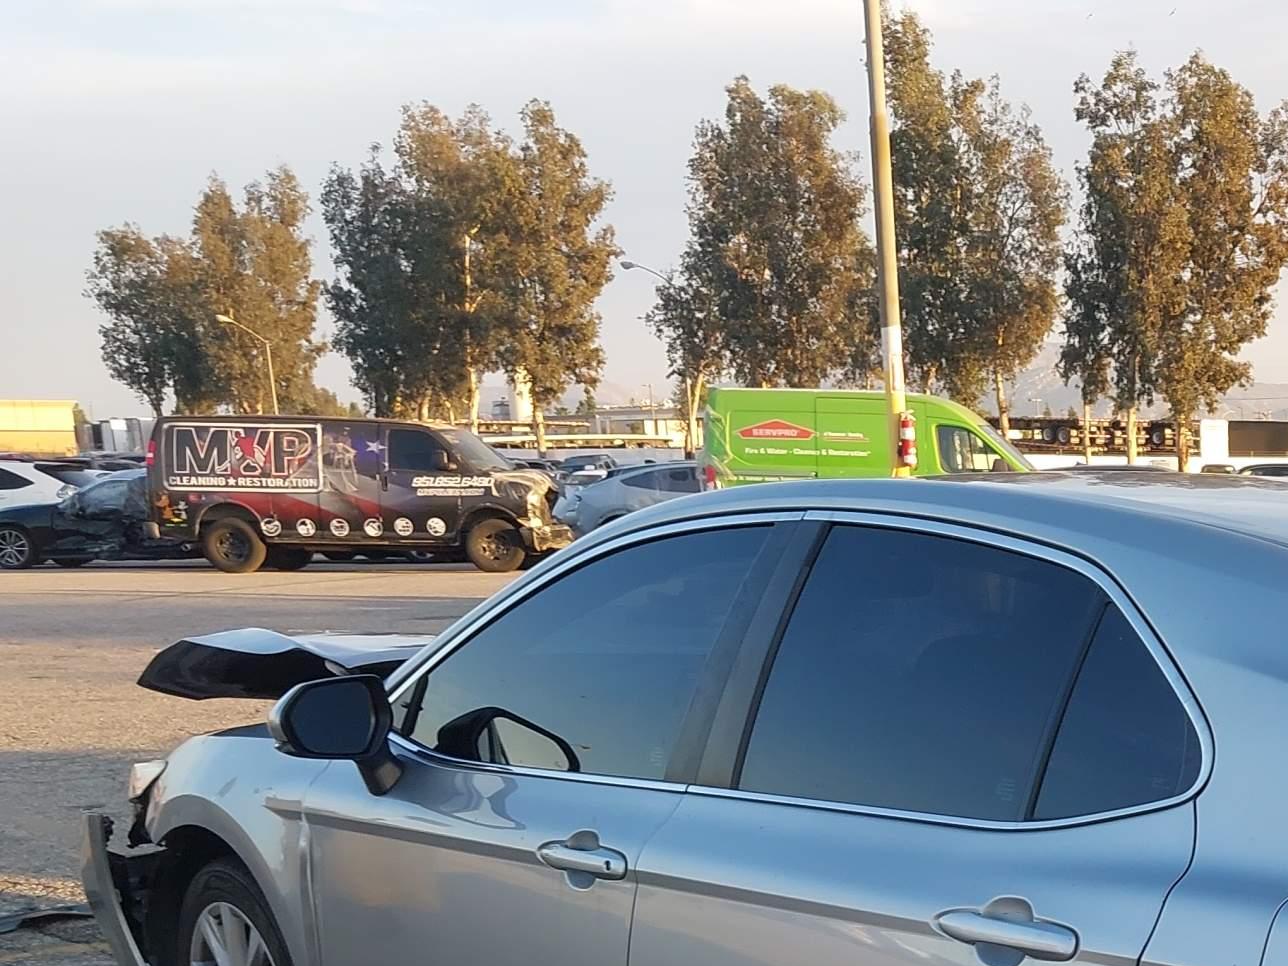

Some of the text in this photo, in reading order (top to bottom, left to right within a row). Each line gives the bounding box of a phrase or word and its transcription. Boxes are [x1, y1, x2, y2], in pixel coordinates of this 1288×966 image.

[766, 447, 788, 455] Water
[169, 476, 318, 488] CLEANING RESTORATION
